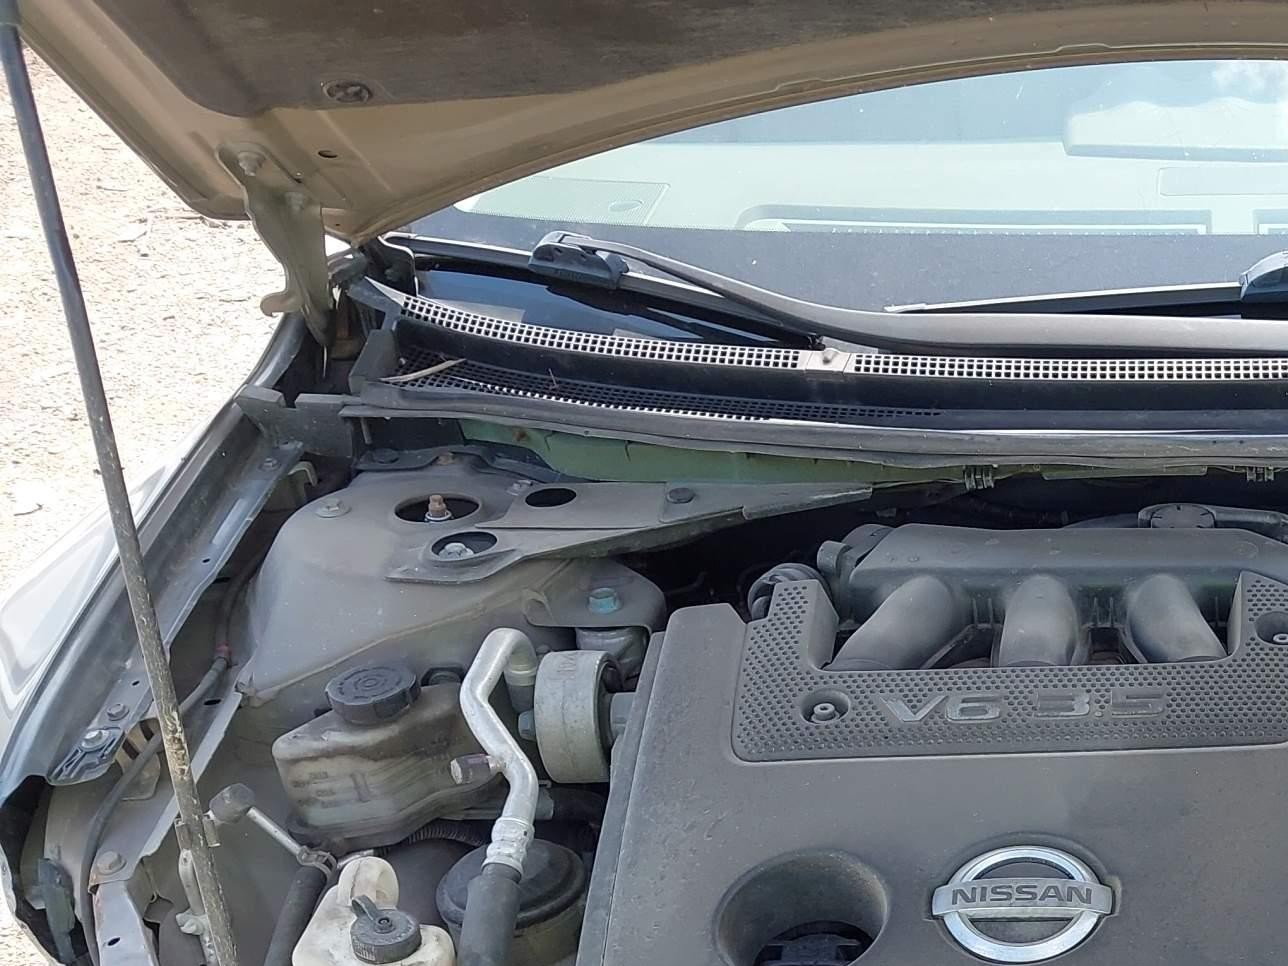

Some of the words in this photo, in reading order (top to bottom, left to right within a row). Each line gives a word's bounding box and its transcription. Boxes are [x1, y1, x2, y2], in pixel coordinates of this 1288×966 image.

[880, 693, 1003, 724] V6
[1034, 688, 1168, 720] 3.5
[952, 884, 1092, 905] NISSAN
